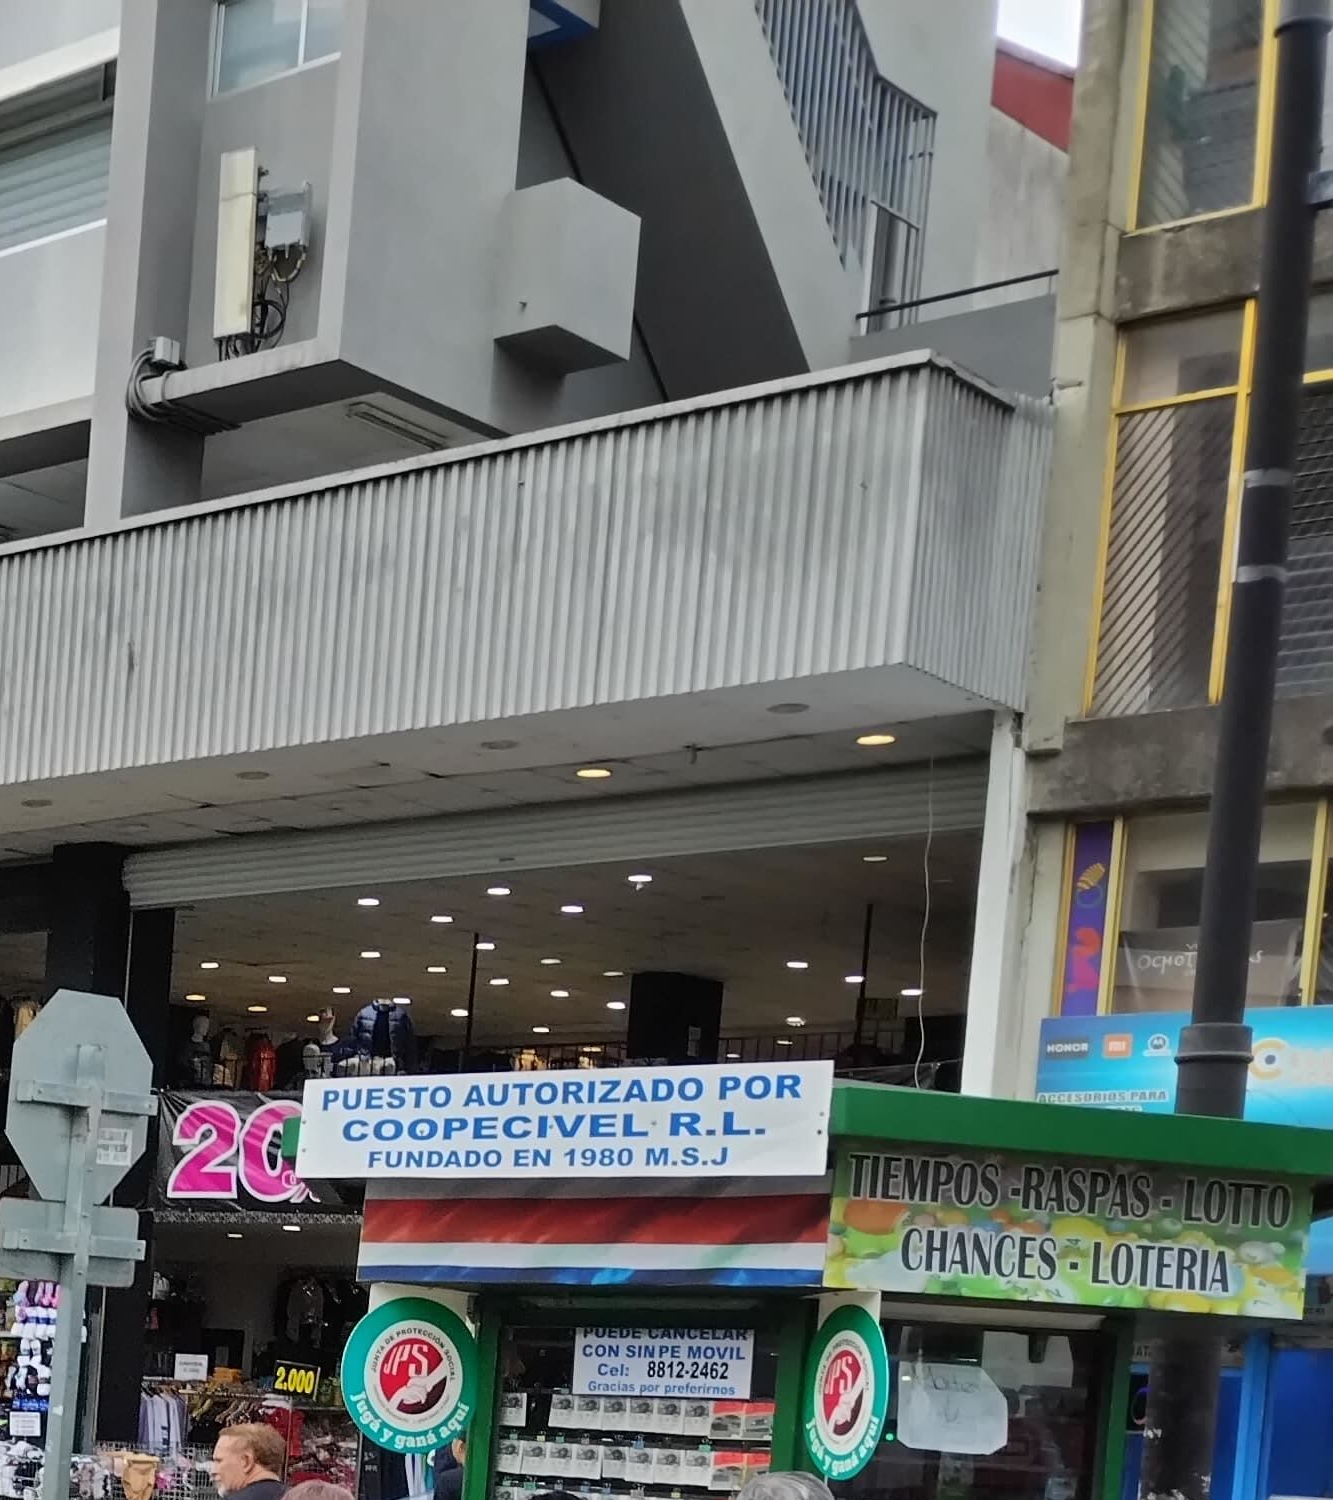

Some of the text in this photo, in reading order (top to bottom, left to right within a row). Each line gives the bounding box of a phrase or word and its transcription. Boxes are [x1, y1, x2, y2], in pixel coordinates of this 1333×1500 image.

[1047, 1043, 1088, 1053] HONOR
[322, 1074, 801, 1111] PUESTO AUTORIZADO POR
[1130, 1090, 1167, 1102] PARA
[342, 1111, 766, 1142] COOPECIVEL R.L.
[368, 1147, 728, 1168] FUNDADO EN 1980 M.S.J
[849, 1153, 1000, 1207] TIEMPOS
[1183, 1179, 1291, 1228] LOTTO
[900, 1228, 1057, 1280] CHANCES
[1091, 1241, 1229, 1293] LOTERIA
[583, 1328, 749, 1341] PUEDE CANCELAR
[372, 1327, 455, 1381] JUNTA DE PROTECCIÓN SOCIAL
[383, 1344, 429, 1377] JPS
[582, 1344, 619, 1358] CON
[687, 1345, 746, 1360] MOVIL
[274, 1366, 314, 1394] 2.000
[597, 1361, 729, 1379] Cel: 8812-2462
[588, 1381, 635, 1392] Gracias
[639, 1383, 660, 1395] por
[350, 1391, 382, 1432] Jugá
[380, 1428, 394, 1442] y
[394, 1431, 437, 1449] ganá
[439, 1402, 470, 1439] aquí
